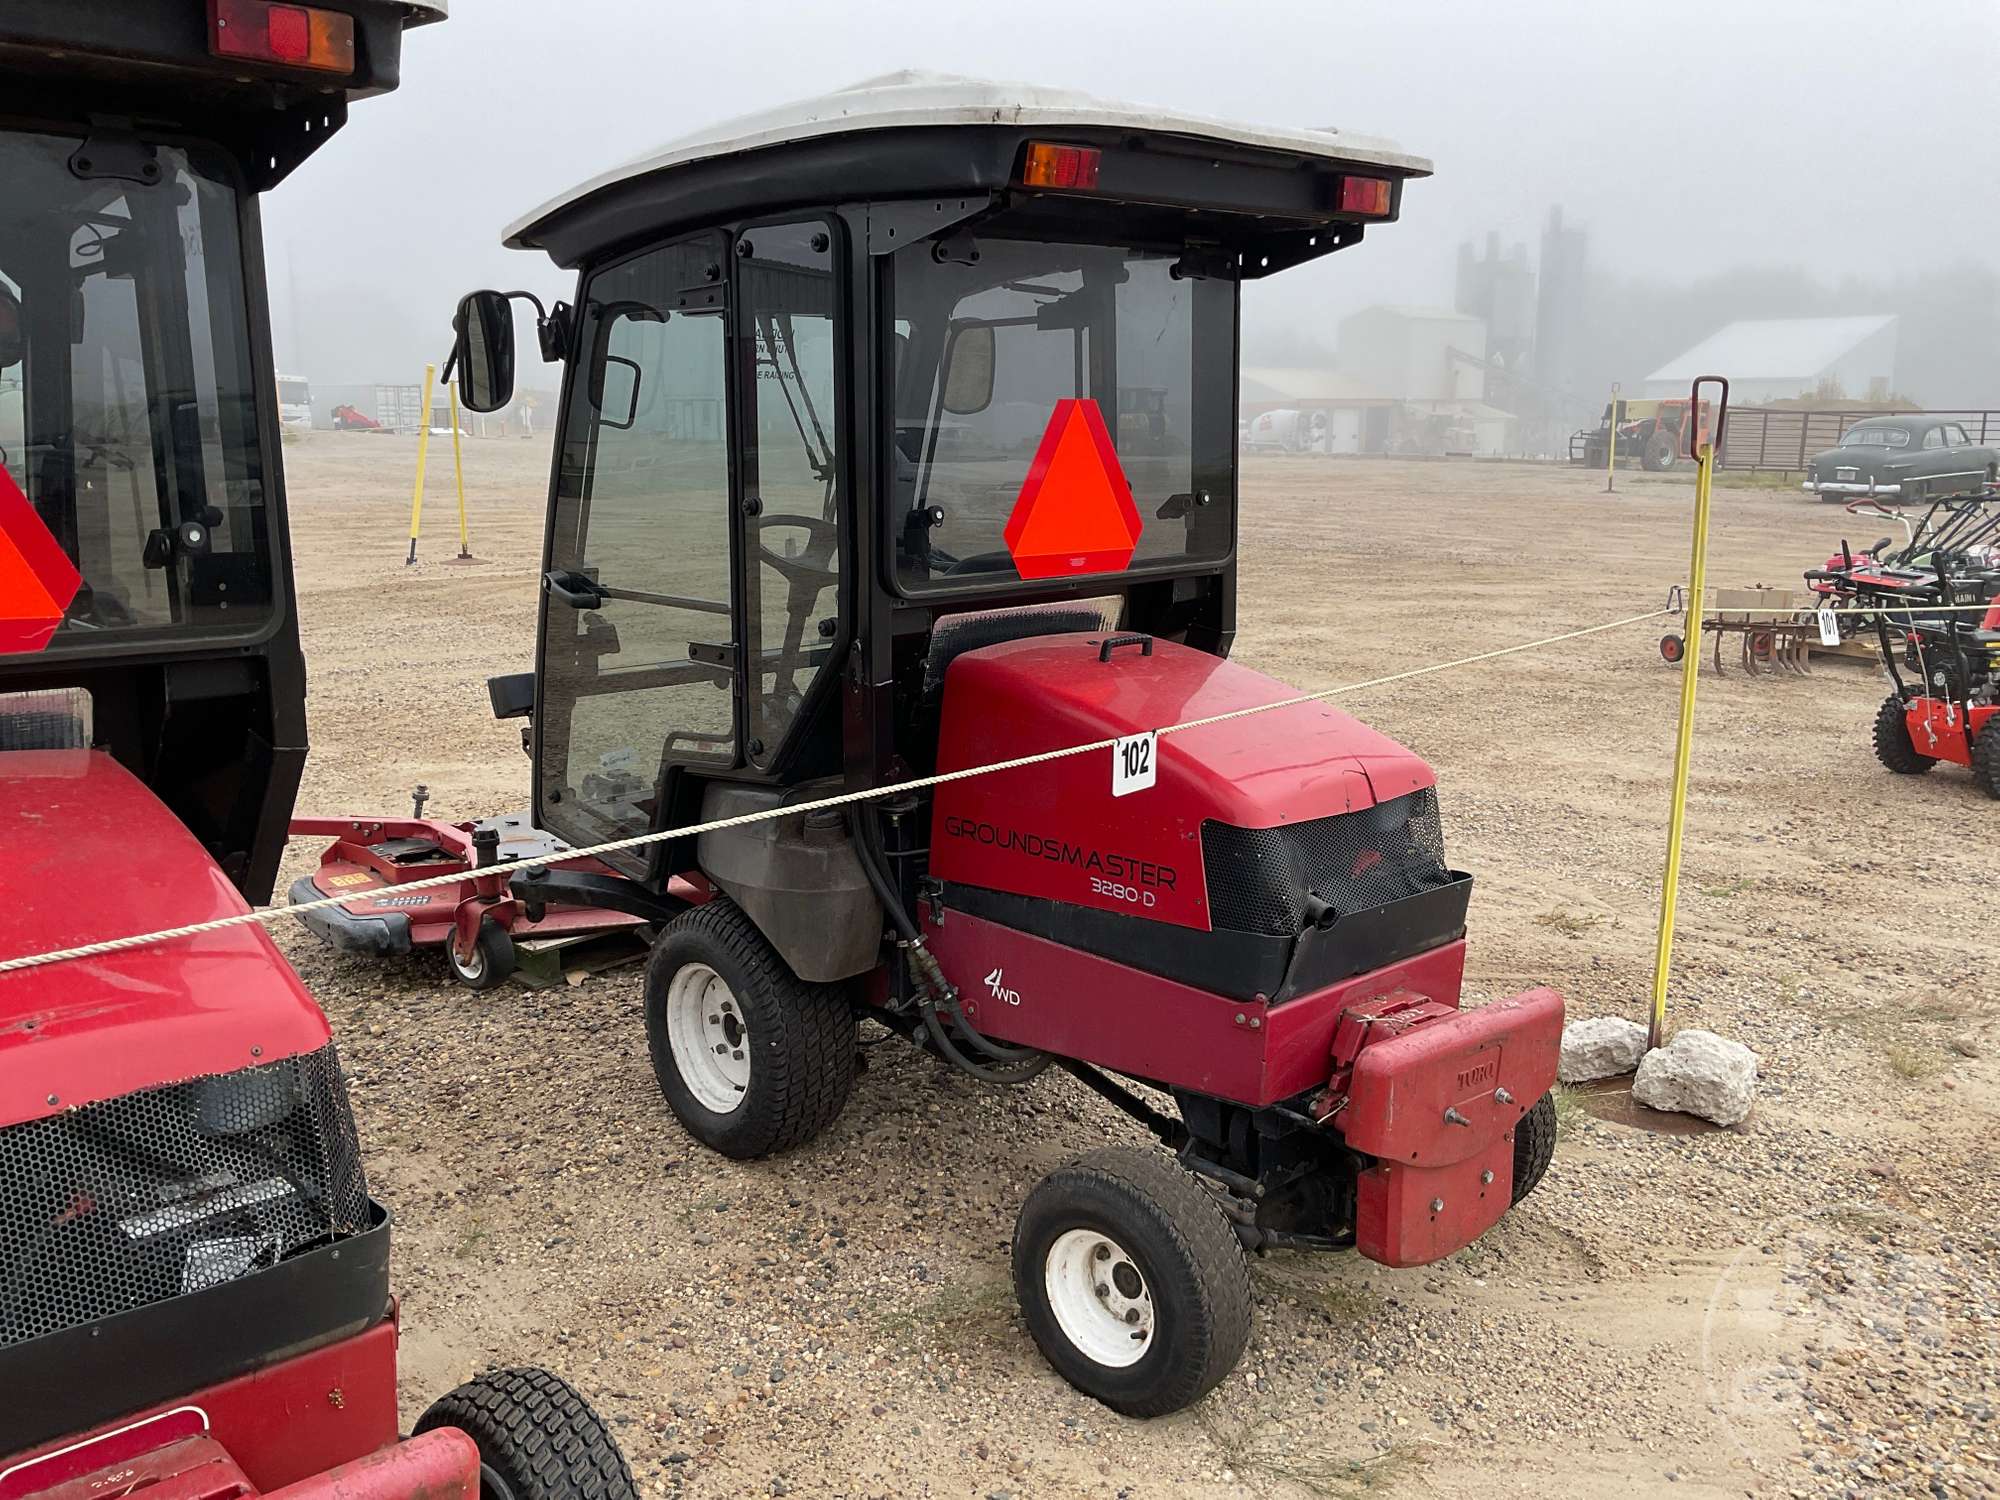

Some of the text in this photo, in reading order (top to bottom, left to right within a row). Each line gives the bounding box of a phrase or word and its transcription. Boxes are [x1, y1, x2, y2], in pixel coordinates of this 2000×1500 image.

[1821, 610, 1836, 636] 101
[1121, 738, 1150, 779] 102
[945, 816, 1177, 892] GROUNDSMASTER
[984, 968, 1020, 1006] 4WD
